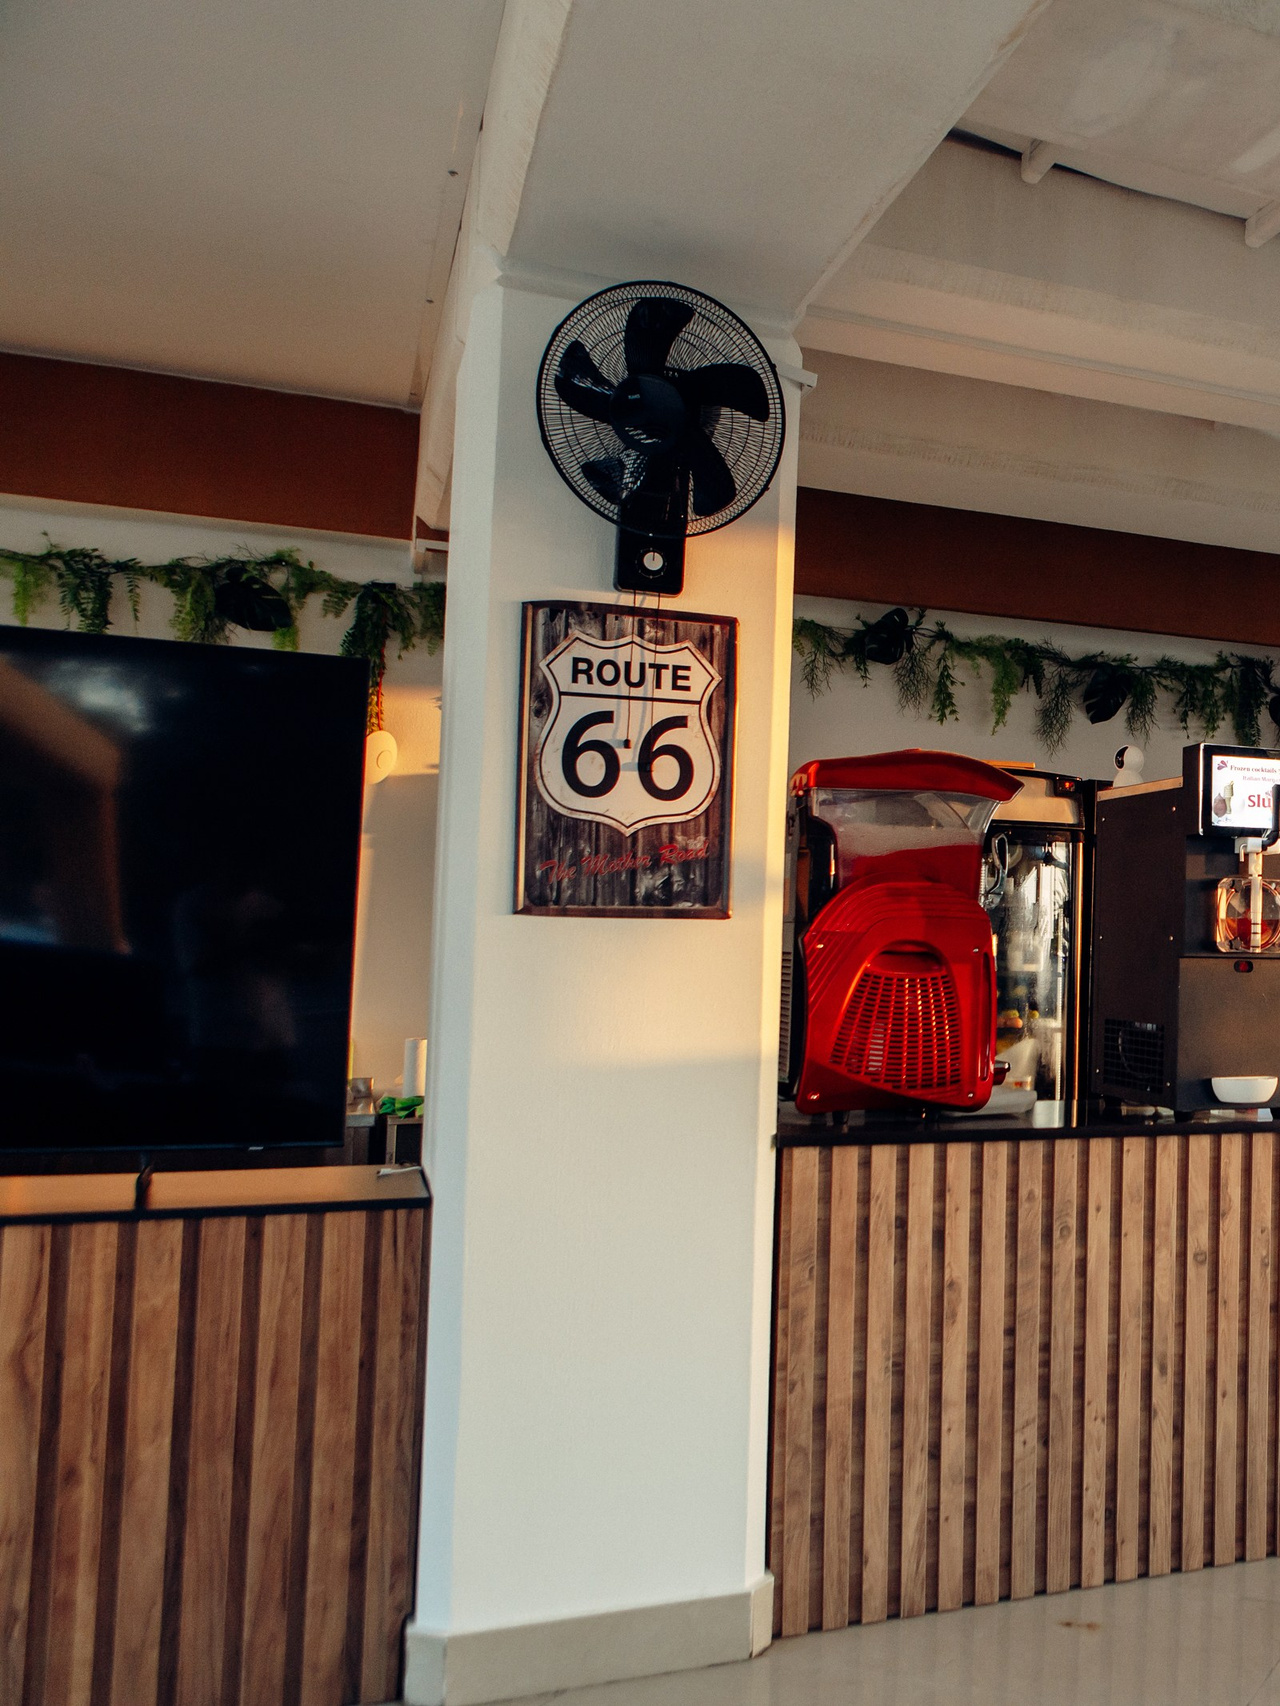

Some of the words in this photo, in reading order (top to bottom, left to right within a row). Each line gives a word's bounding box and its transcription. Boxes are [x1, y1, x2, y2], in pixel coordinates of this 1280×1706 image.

[571, 656, 692, 692] ROUTE
[561, 710, 695, 802] 66
[1230, 764, 1250, 772] Frozen
[539, 859, 577, 885] The
[581, 851, 653, 876] Mother
[658, 840, 710, 866] Road
